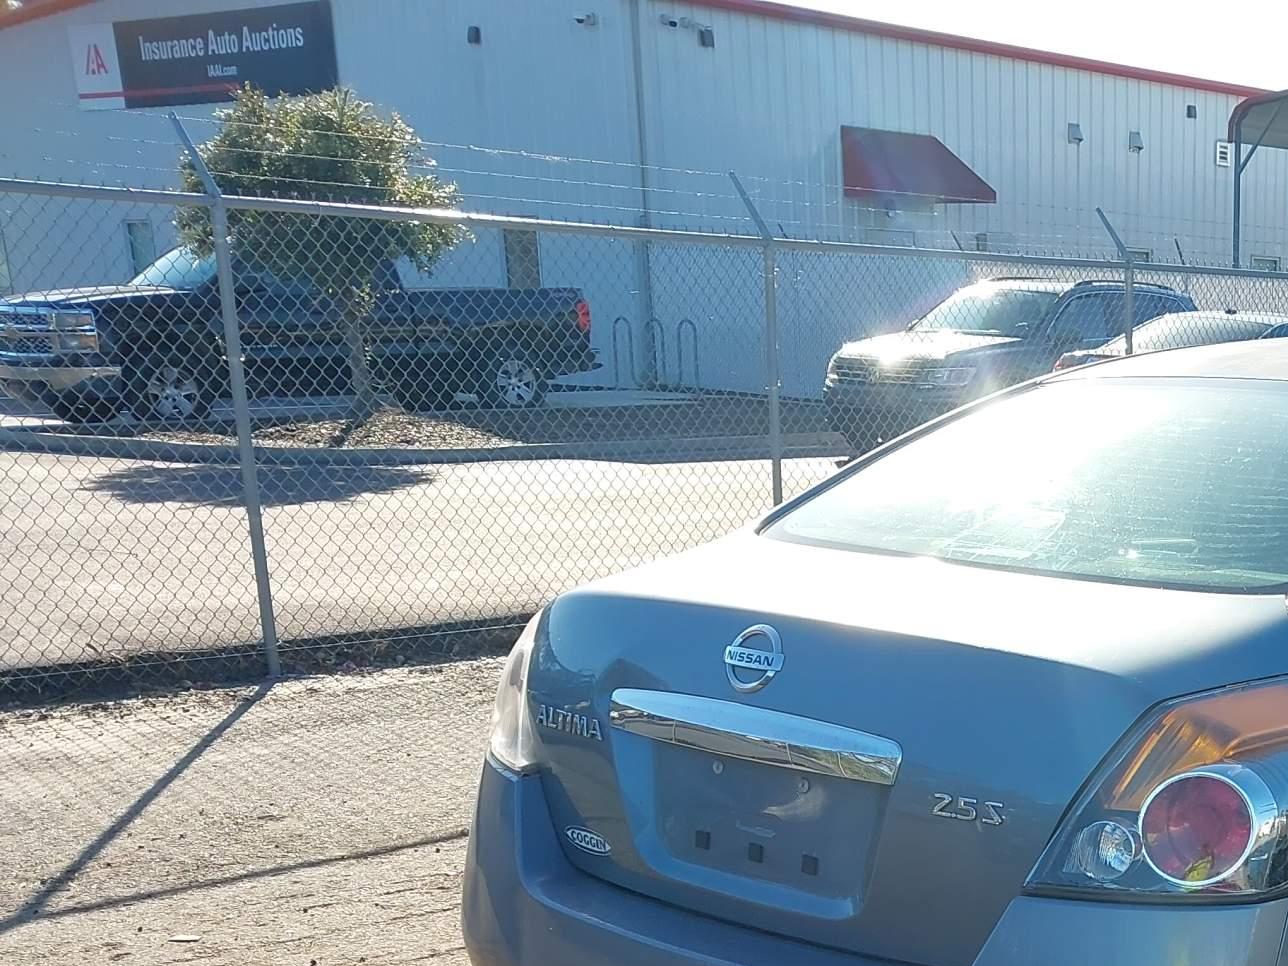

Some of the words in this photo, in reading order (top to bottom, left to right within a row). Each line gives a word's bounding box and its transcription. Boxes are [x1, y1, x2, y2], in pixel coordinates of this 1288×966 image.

[138, 35, 204, 61] Insurance
[207, 29, 239, 55] Auto
[242, 23, 304, 52] Auctions
[727, 649, 775, 667] NISSAN
[536, 703, 603, 741] ALTIMA
[570, 829, 607, 852] COGGIN
